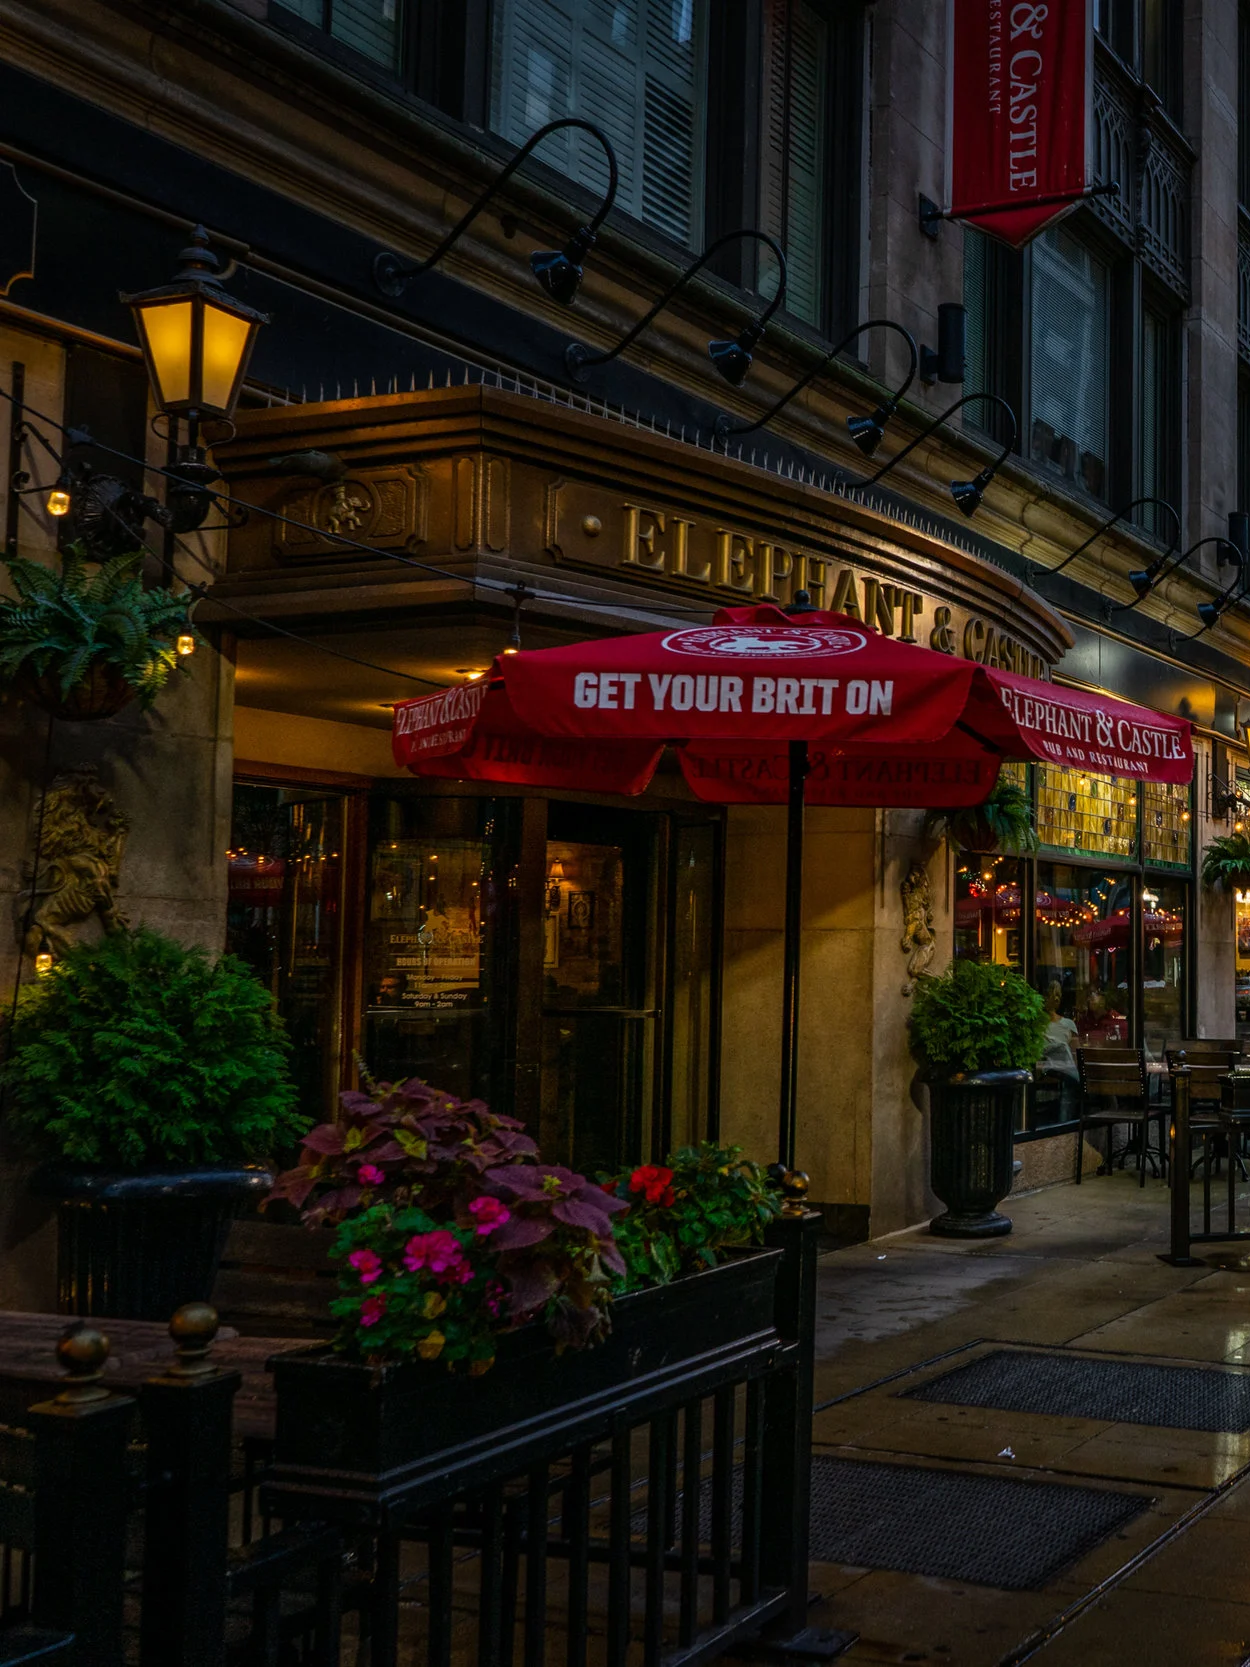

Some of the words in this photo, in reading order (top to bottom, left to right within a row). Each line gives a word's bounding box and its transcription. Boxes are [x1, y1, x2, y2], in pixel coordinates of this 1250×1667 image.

[1010, 2, 1048, 41] &
[1009, 50, 1042, 192] CASTLE
[622, 502, 923, 643] ELEPHANT
[930, 606, 956, 655] &
[574, 672, 642, 709] GET
[648, 674, 743, 712] YOUR
[751, 677, 839, 715] BRIT
[846, 680, 894, 716] ON
[1000, 686, 1093, 743] ELEPHANT
[1095, 709, 1115, 748] &
[1117, 719, 1187, 760] CASTLE
[1042, 740, 1062, 756] PUB
[1066, 746, 1085, 761] AND
[1089, 751, 1149, 774] RESTAURANT
[401, 993, 433, 1001] Saturday
[440, 993, 467, 1001] Sunday
